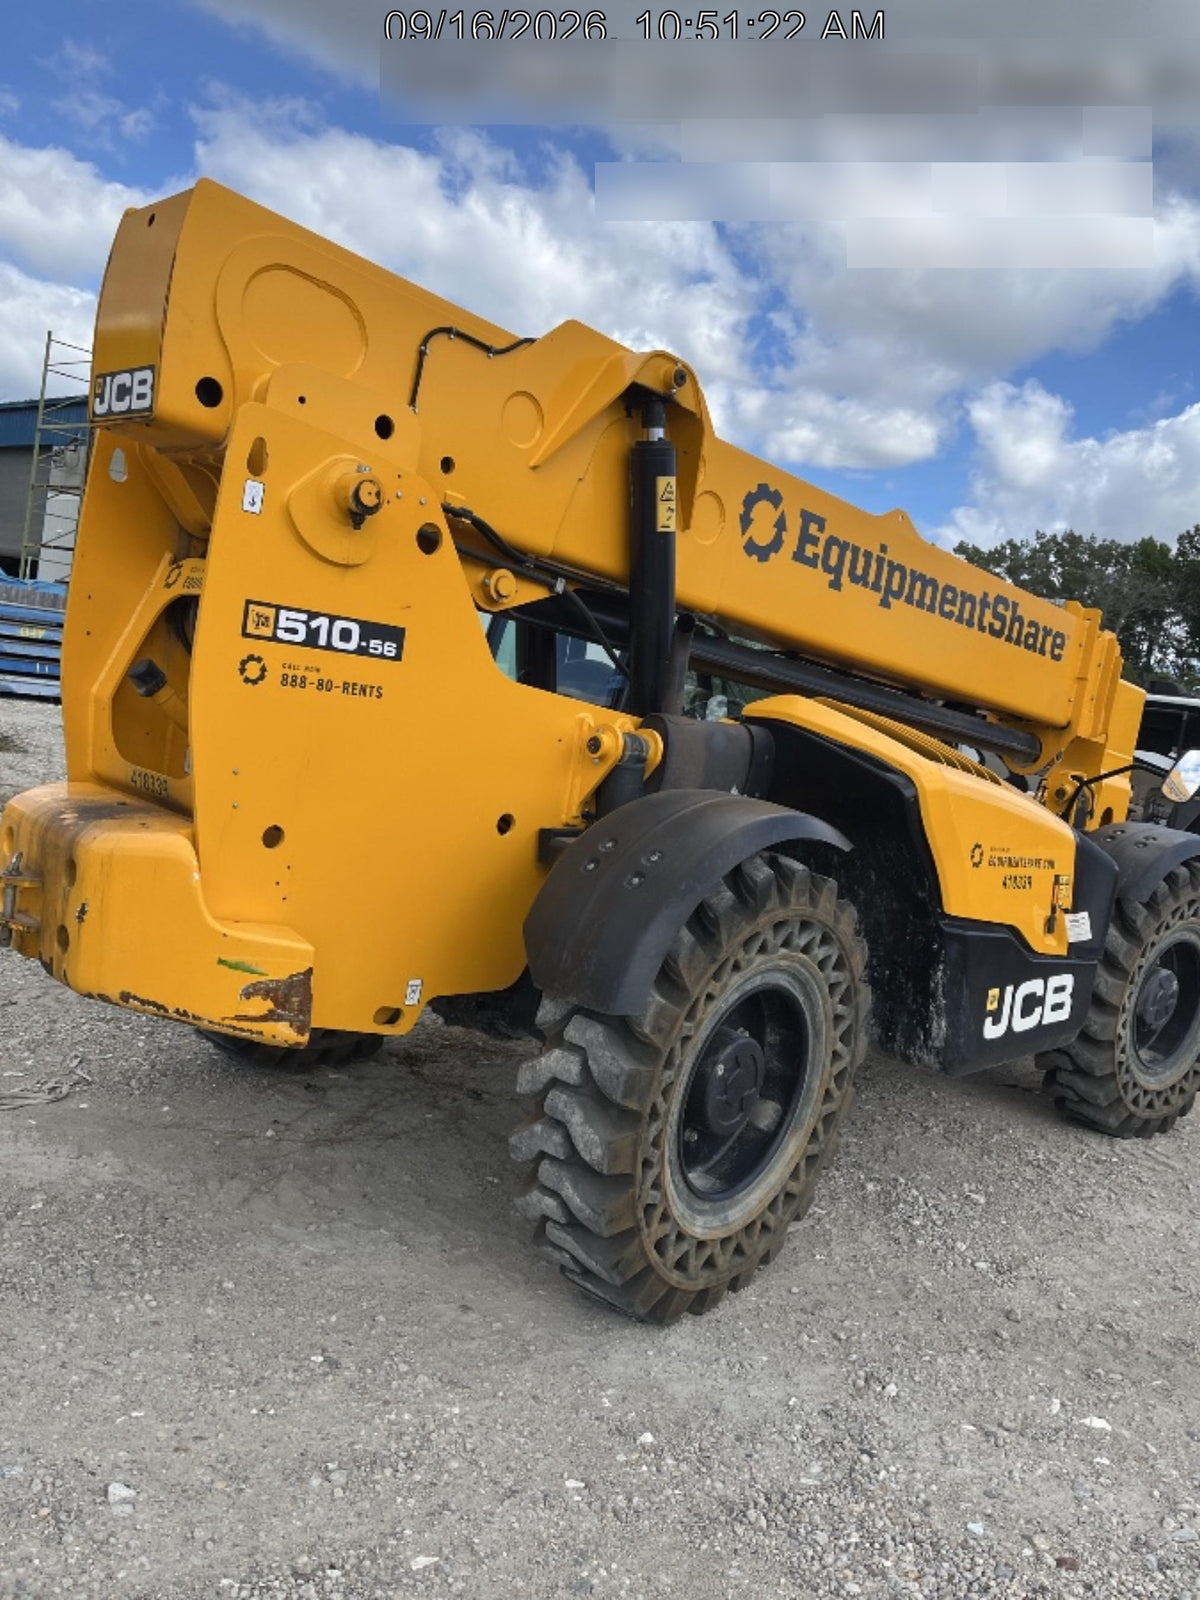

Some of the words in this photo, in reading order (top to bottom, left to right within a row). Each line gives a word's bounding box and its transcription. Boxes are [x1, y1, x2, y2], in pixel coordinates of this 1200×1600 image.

[94, 369, 154, 415] JCB
[792, 508, 1066, 662] EquipmentShare
[280, 672, 384, 699] 888-80-RENTS
[983, 973, 1075, 1040] JCB
